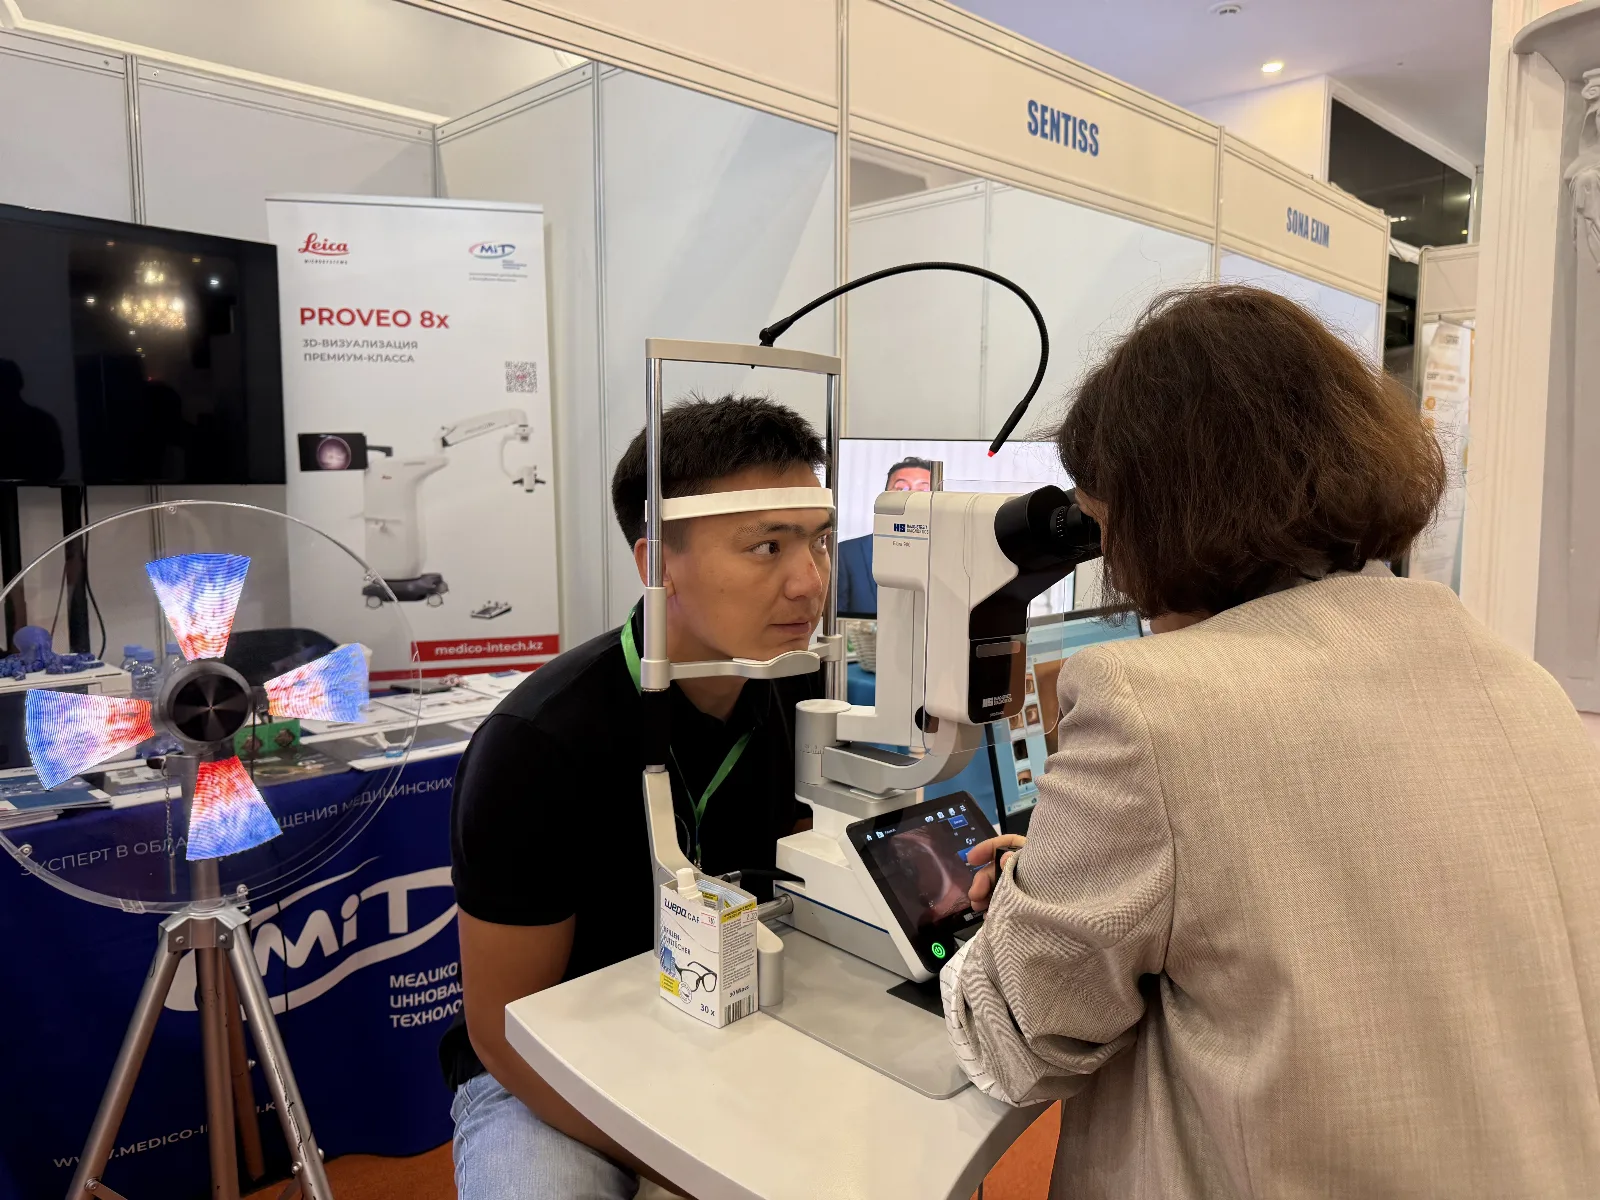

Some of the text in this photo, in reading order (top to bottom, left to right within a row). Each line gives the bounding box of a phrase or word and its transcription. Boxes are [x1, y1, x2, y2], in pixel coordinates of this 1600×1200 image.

[1027, 99, 1099, 157] SENTISS
[1311, 217, 1330, 248] EXIM
[298, 232, 350, 256] Leica
[300, 307, 450, 329] PROVEO 8x
[302, 338, 418, 350] 3D-ВИЗУАЛИЗАЦИЯ
[303, 352, 415, 364] ПРЕМИУМ-КЛАССА
[434, 640, 544, 656] medico-intech.kz
[117, 844, 129, 858] В
[133, 836, 188, 855] ОБЛА
[278, 804, 338, 828] ЩЕНИЯ
[664, 897, 687, 918] wepa
[389, 998, 463, 1028] ТЕХНОЛО
[700, 1003, 710, 1014] 30
